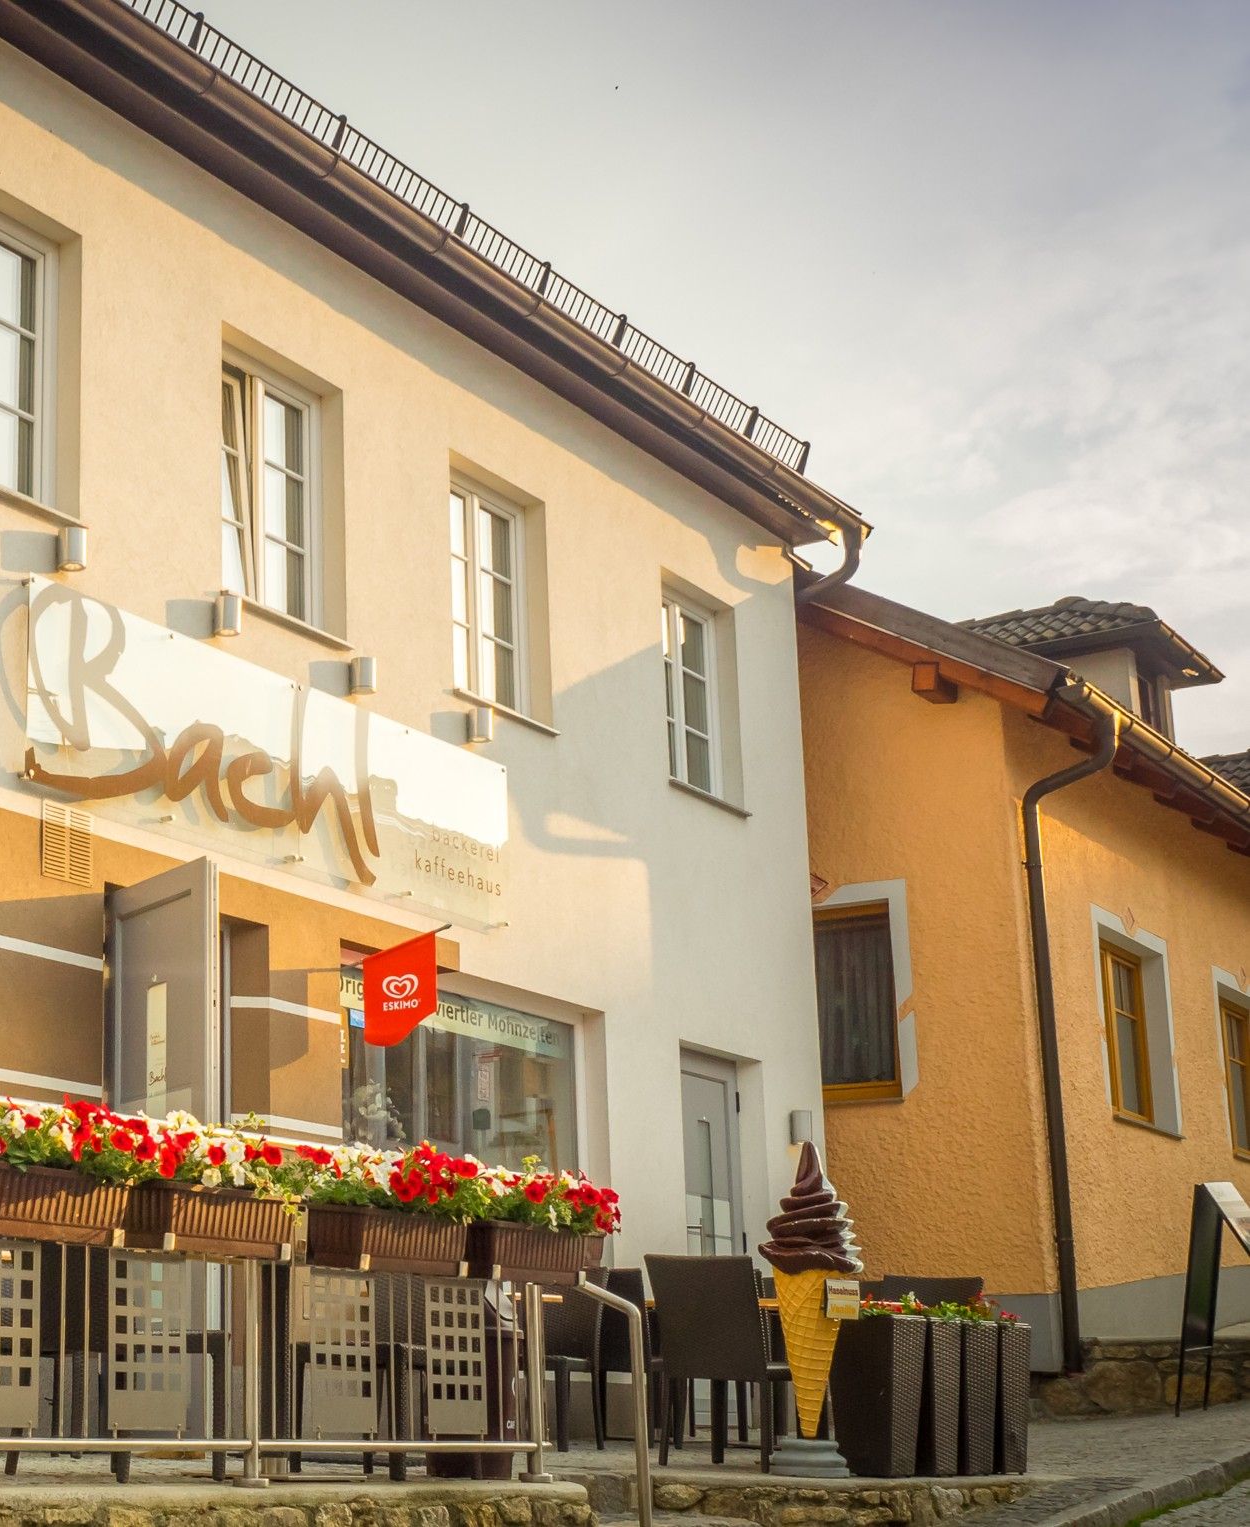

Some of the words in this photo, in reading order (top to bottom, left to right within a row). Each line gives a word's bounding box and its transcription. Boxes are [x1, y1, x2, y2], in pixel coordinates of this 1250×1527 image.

[25, 583, 380, 886] Bachl
[414, 848, 501, 897] kaffeehaus
[382, 998, 419, 1012] ESKIMO
